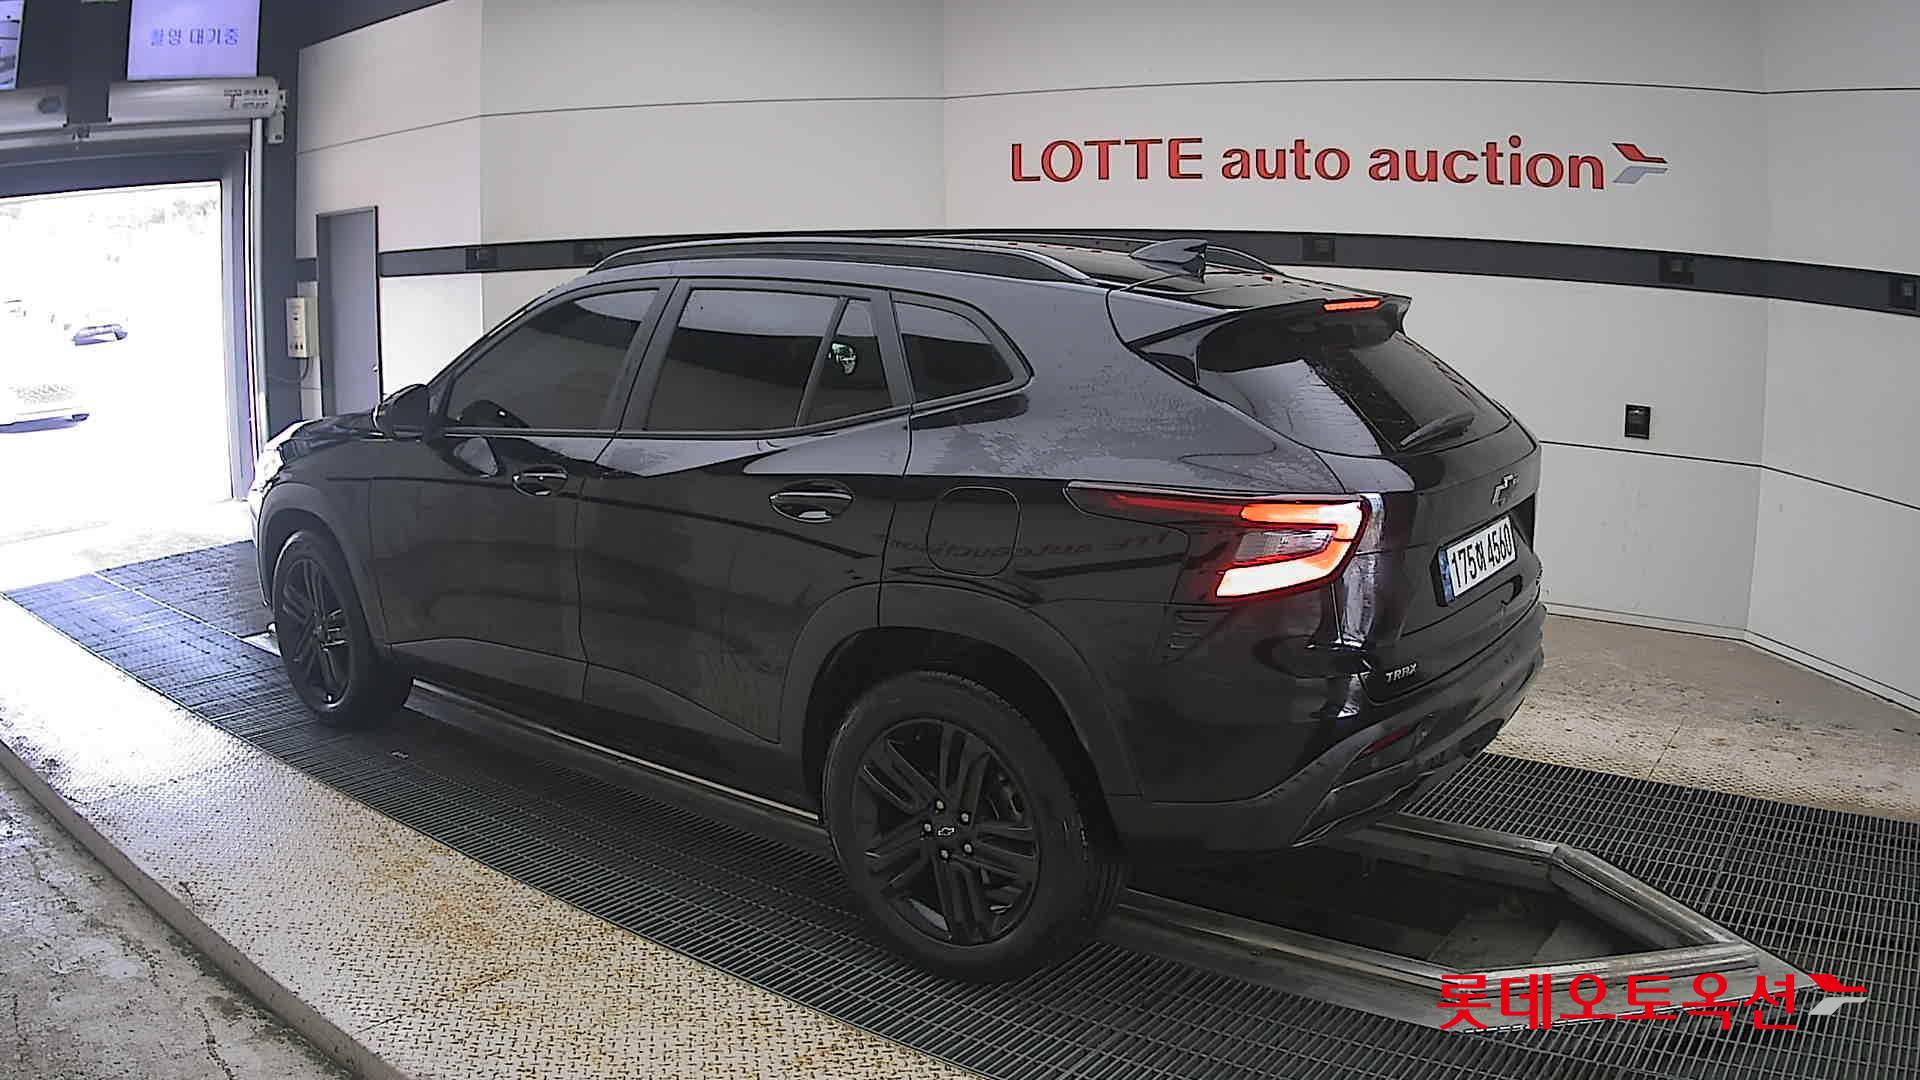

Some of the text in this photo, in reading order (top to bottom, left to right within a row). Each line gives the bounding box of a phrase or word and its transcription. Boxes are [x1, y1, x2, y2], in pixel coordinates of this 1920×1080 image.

[189, 27, 240, 47] 대기중
[1011, 134, 1605, 190] LOTTE auto auction
[1487, 523, 1513, 567] 4560
[1385, 662, 1417, 683] TRAX
